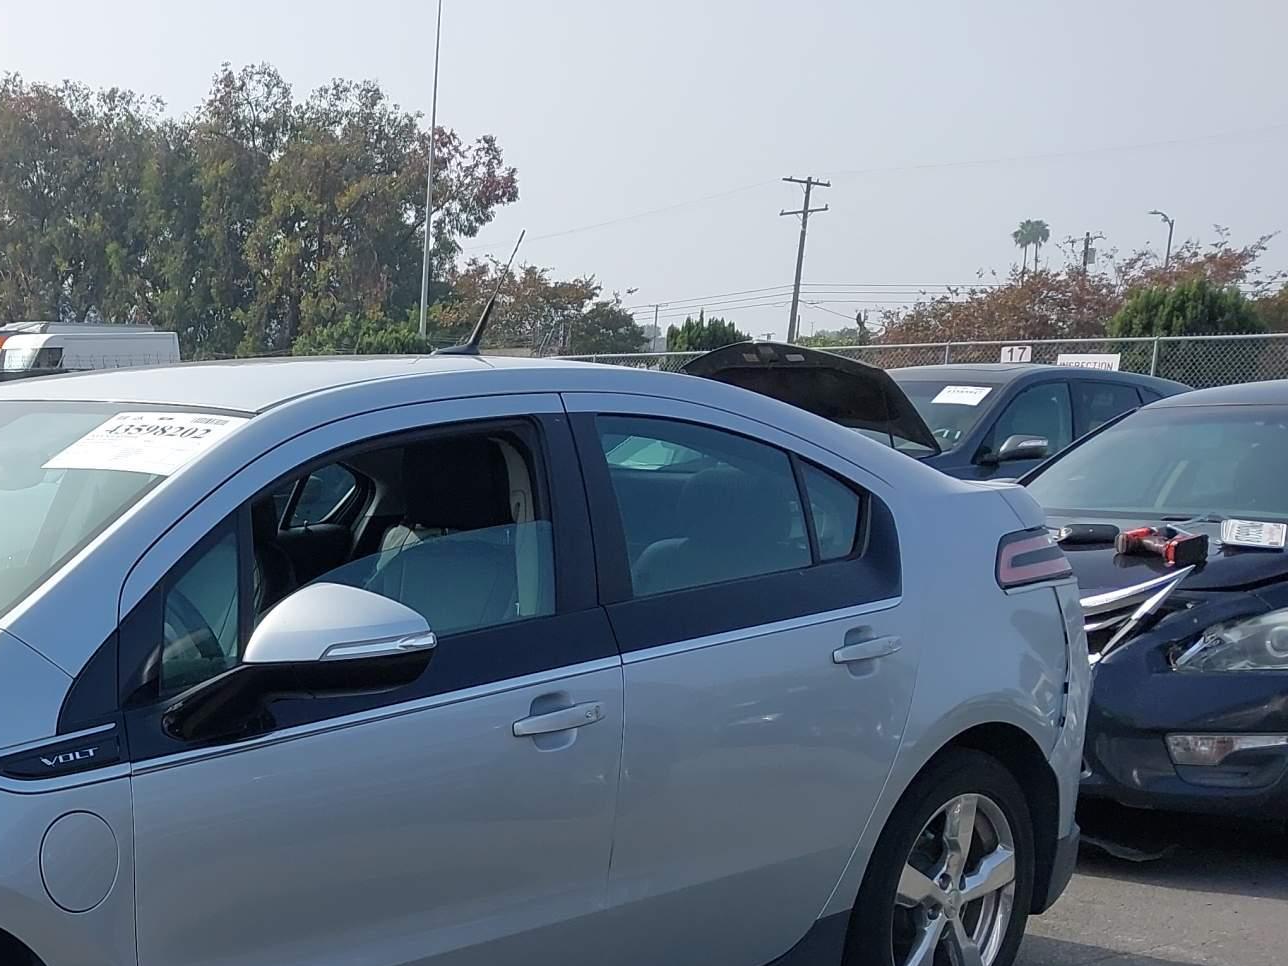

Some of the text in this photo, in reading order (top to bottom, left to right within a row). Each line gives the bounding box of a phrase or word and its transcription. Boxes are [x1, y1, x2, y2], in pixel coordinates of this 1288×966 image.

[1007, 347, 1027, 362] 17
[105, 424, 211, 439] 43598202
[40, 747, 99, 767] VOLT
